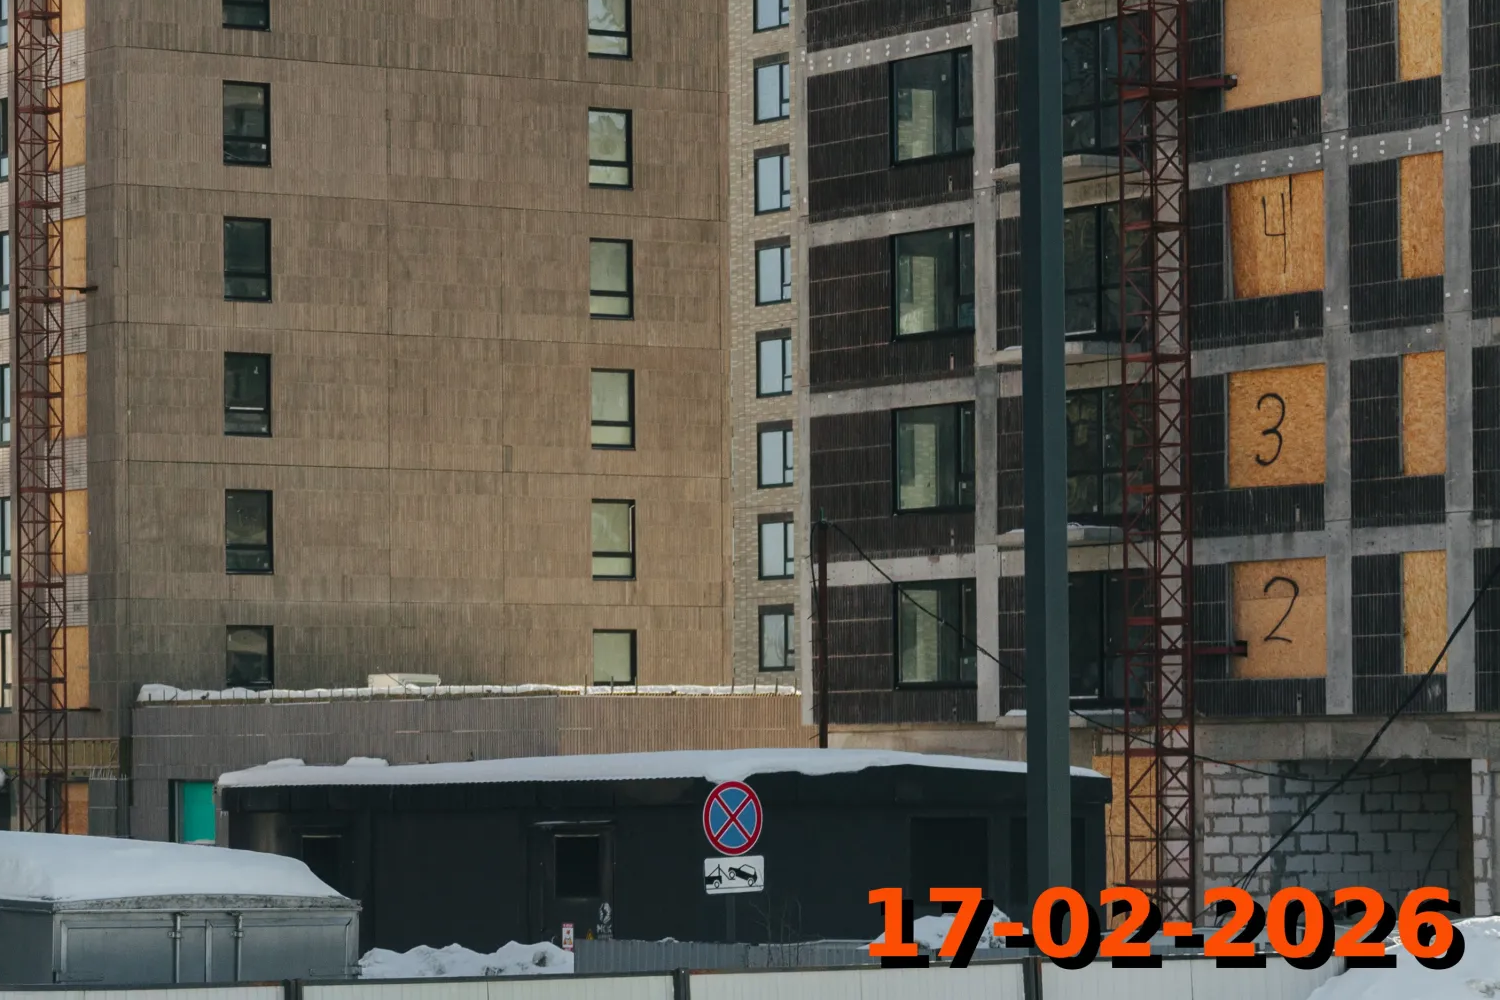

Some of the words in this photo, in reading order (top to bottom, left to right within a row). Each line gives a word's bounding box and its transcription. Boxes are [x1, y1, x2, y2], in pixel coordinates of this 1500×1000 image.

[1261, 192, 1287, 274] 4
[1255, 392, 1286, 467] 3
[1263, 576, 1299, 643] 2
